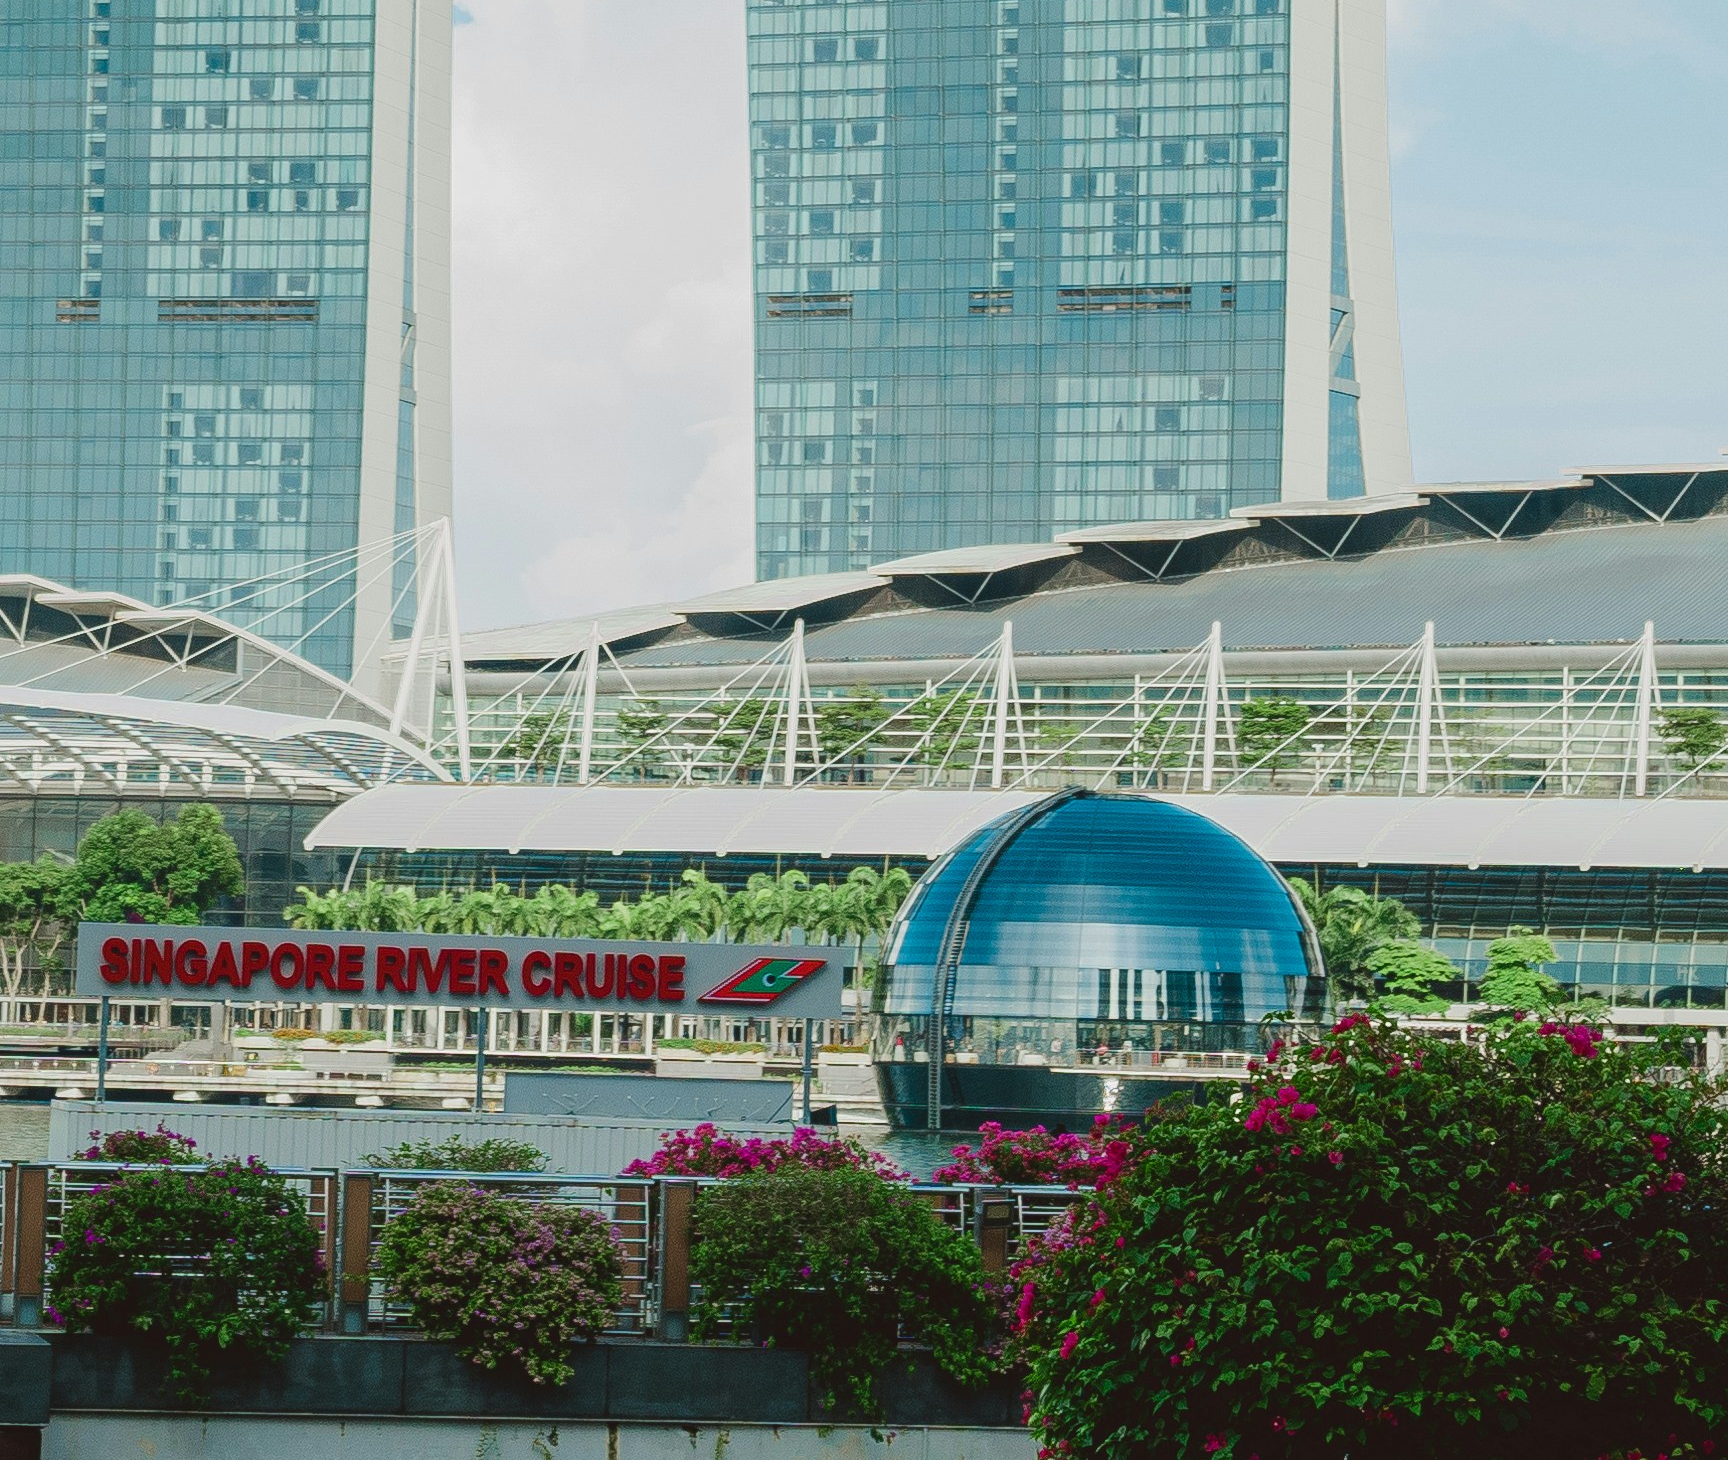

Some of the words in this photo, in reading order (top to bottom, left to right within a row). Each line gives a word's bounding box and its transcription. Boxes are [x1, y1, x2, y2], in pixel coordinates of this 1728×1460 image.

[99, 937, 366, 991] SINGAPORE
[375, 945, 509, 995] RIVER
[521, 950, 686, 1001] CRUISE
